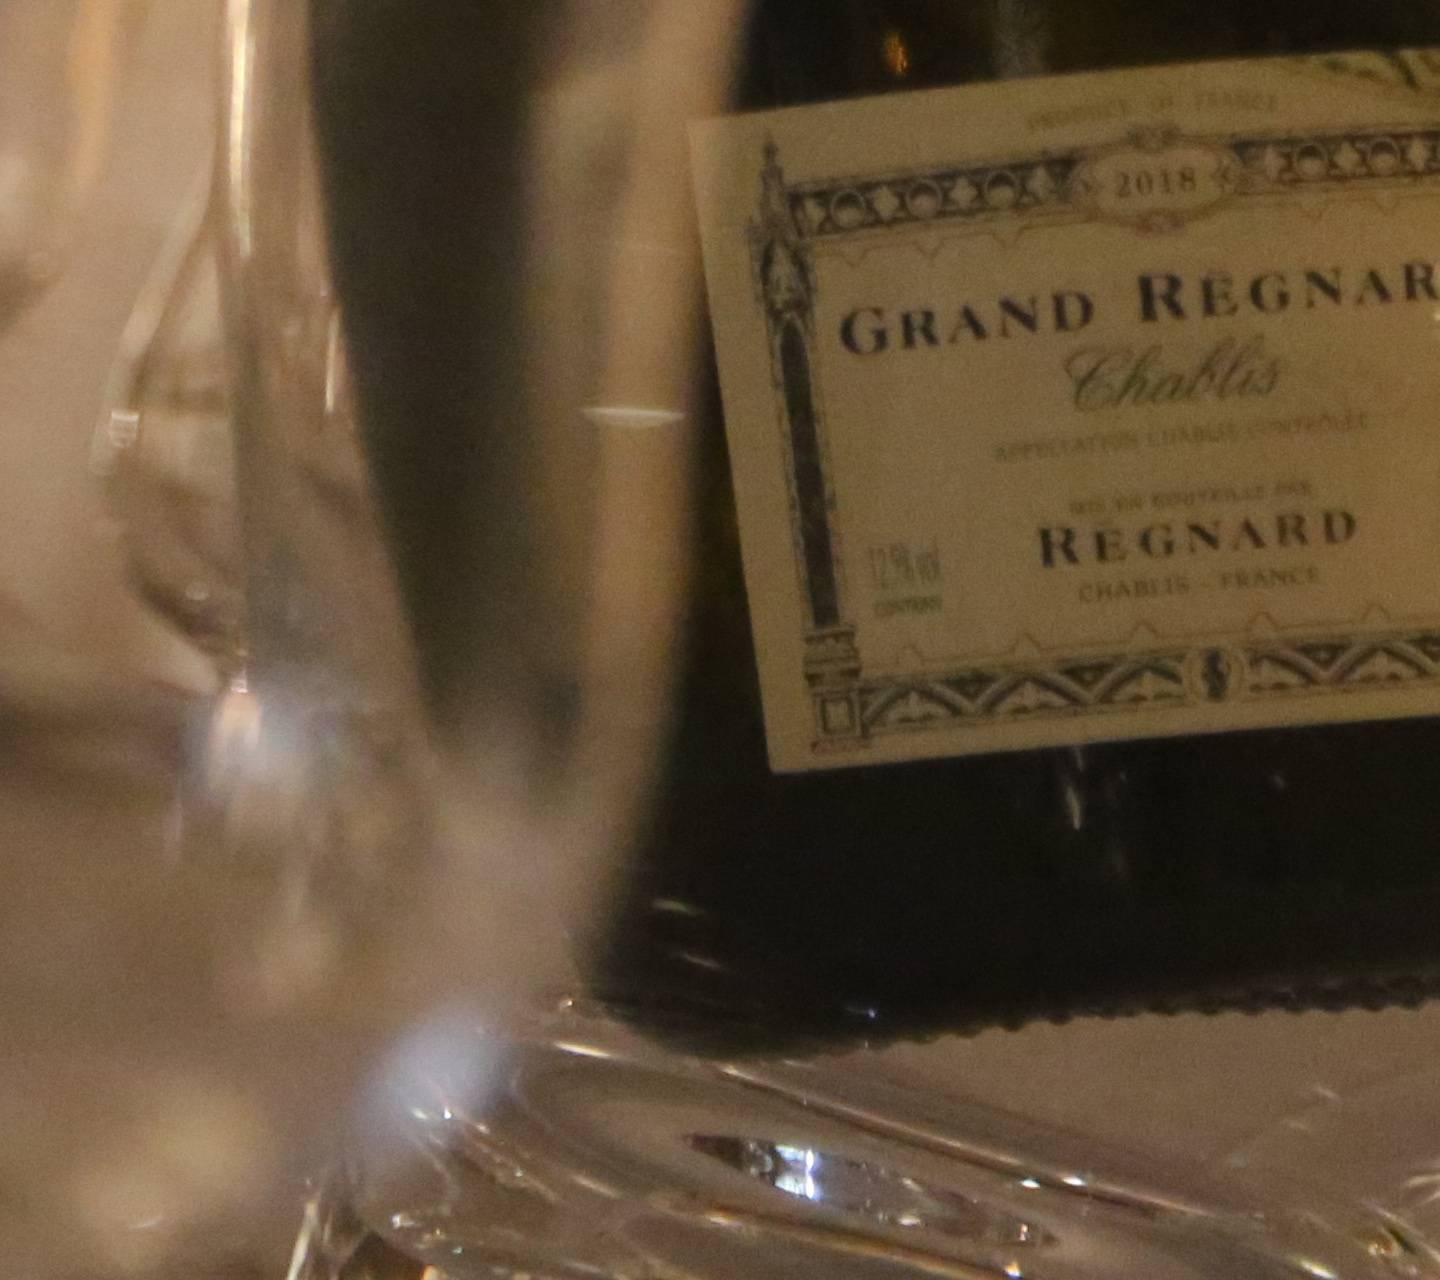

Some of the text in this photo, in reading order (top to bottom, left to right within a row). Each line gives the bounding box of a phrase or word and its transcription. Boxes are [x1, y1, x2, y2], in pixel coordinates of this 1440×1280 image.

[1115, 167, 1197, 199] 2018
[839, 291, 1095, 356] GRAND
[1065, 335, 1279, 412] Chablis
[1078, 576, 1191, 604] CHABLIS
[1219, 565, 1320, 590] FRANCE
